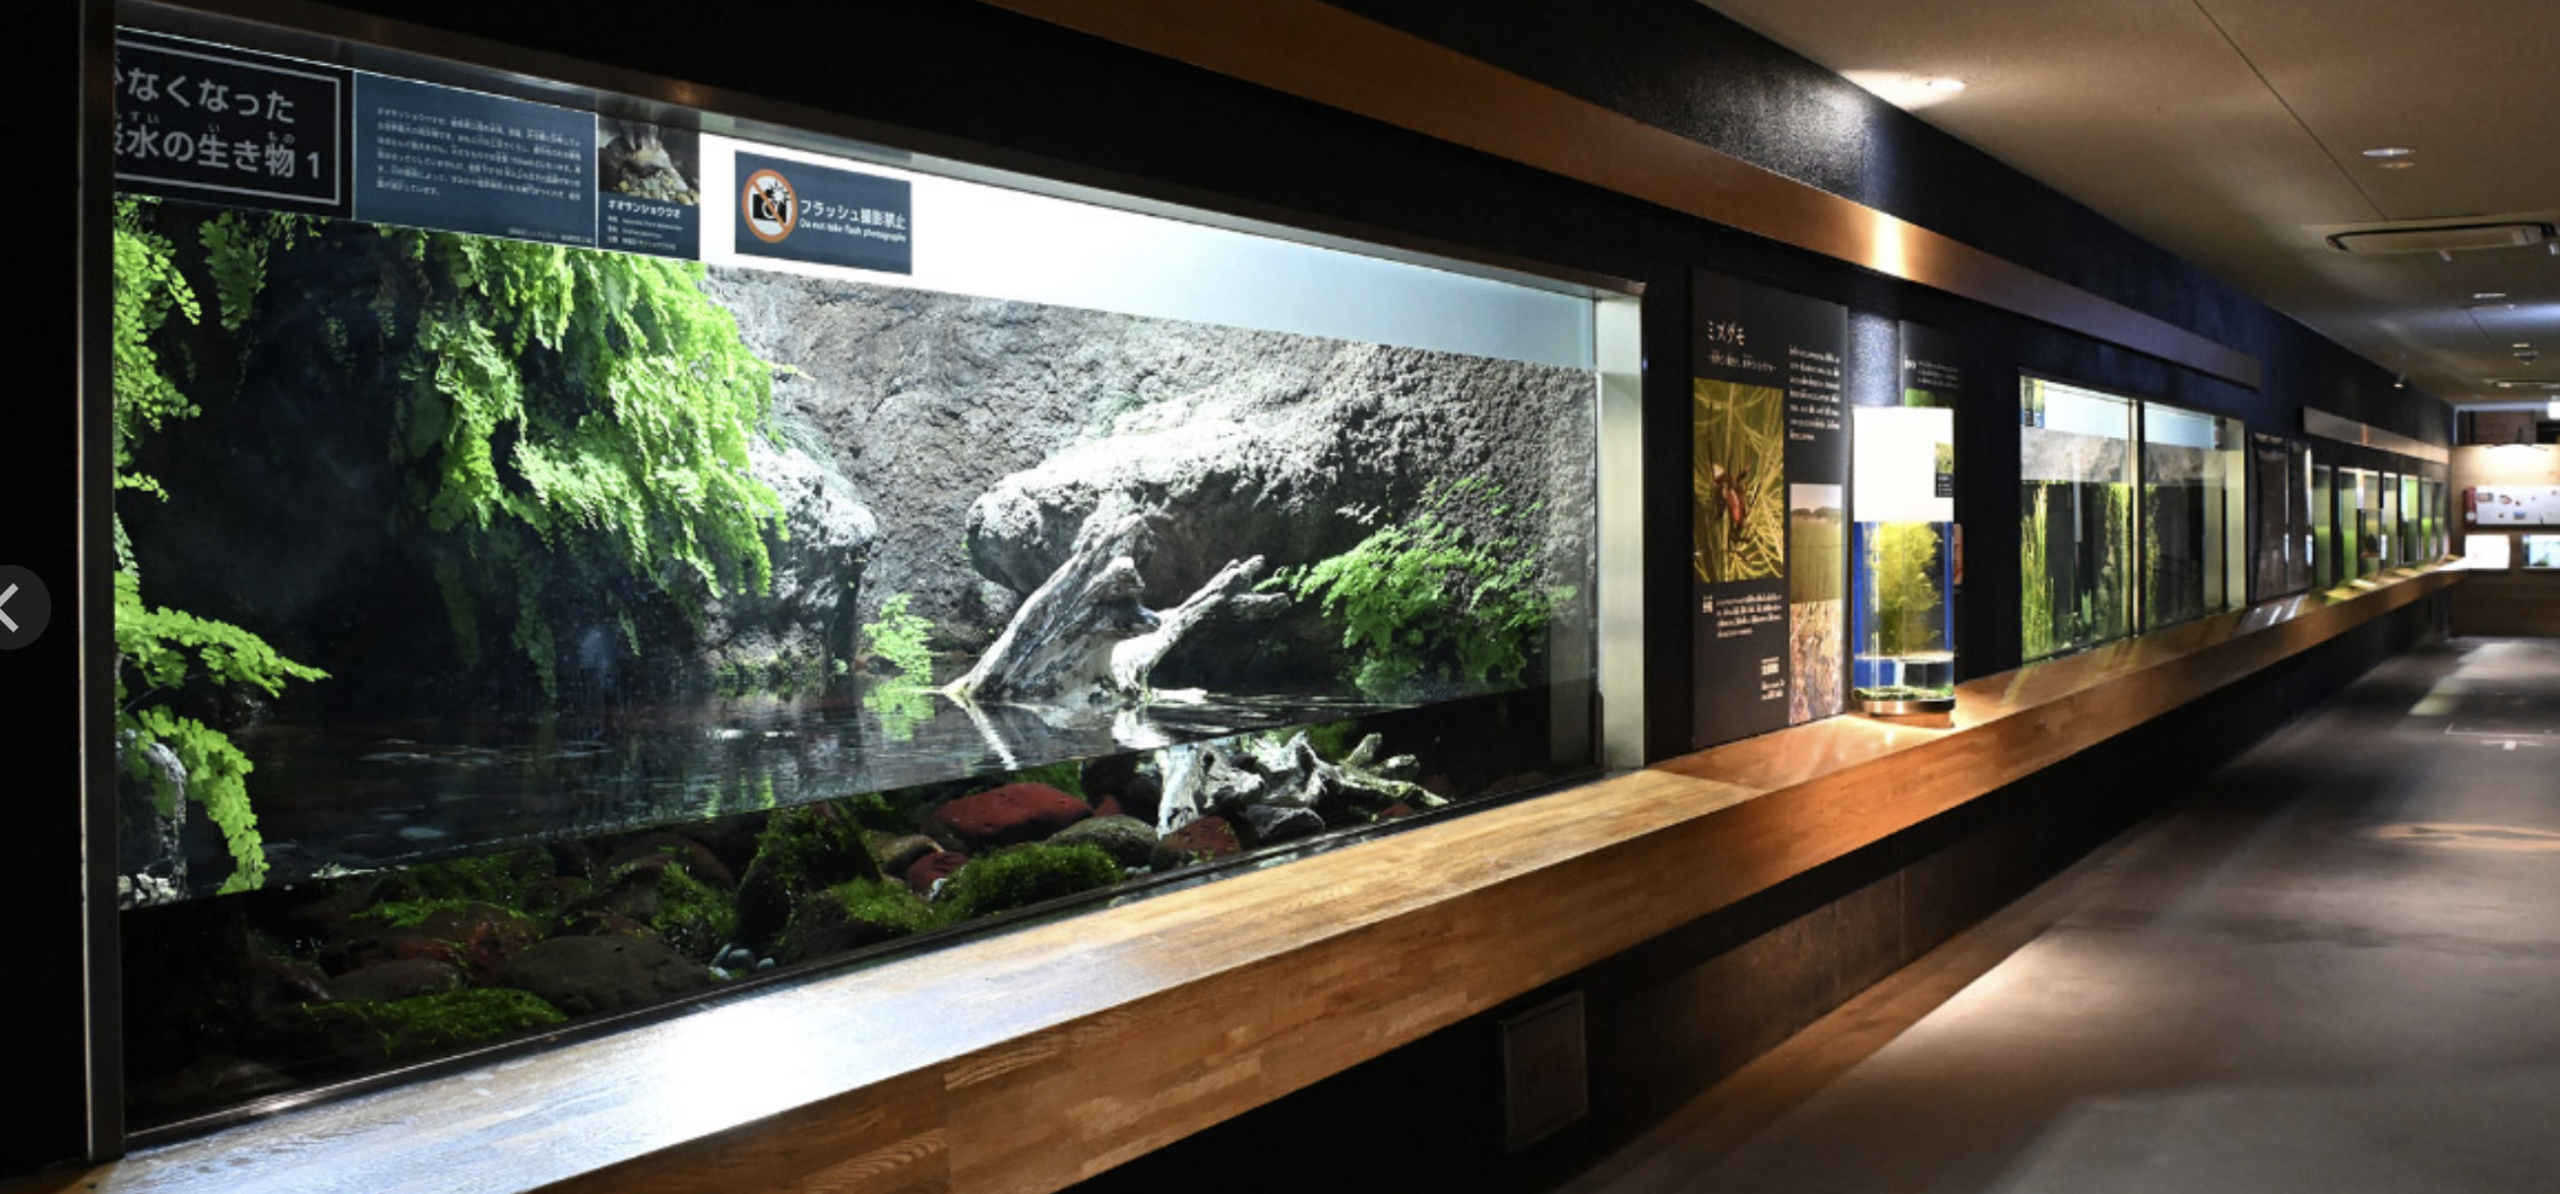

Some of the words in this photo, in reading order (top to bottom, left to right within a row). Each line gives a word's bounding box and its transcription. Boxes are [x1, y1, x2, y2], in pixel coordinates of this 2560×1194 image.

[800, 199, 907, 230] フラッシュ撮影禁止
